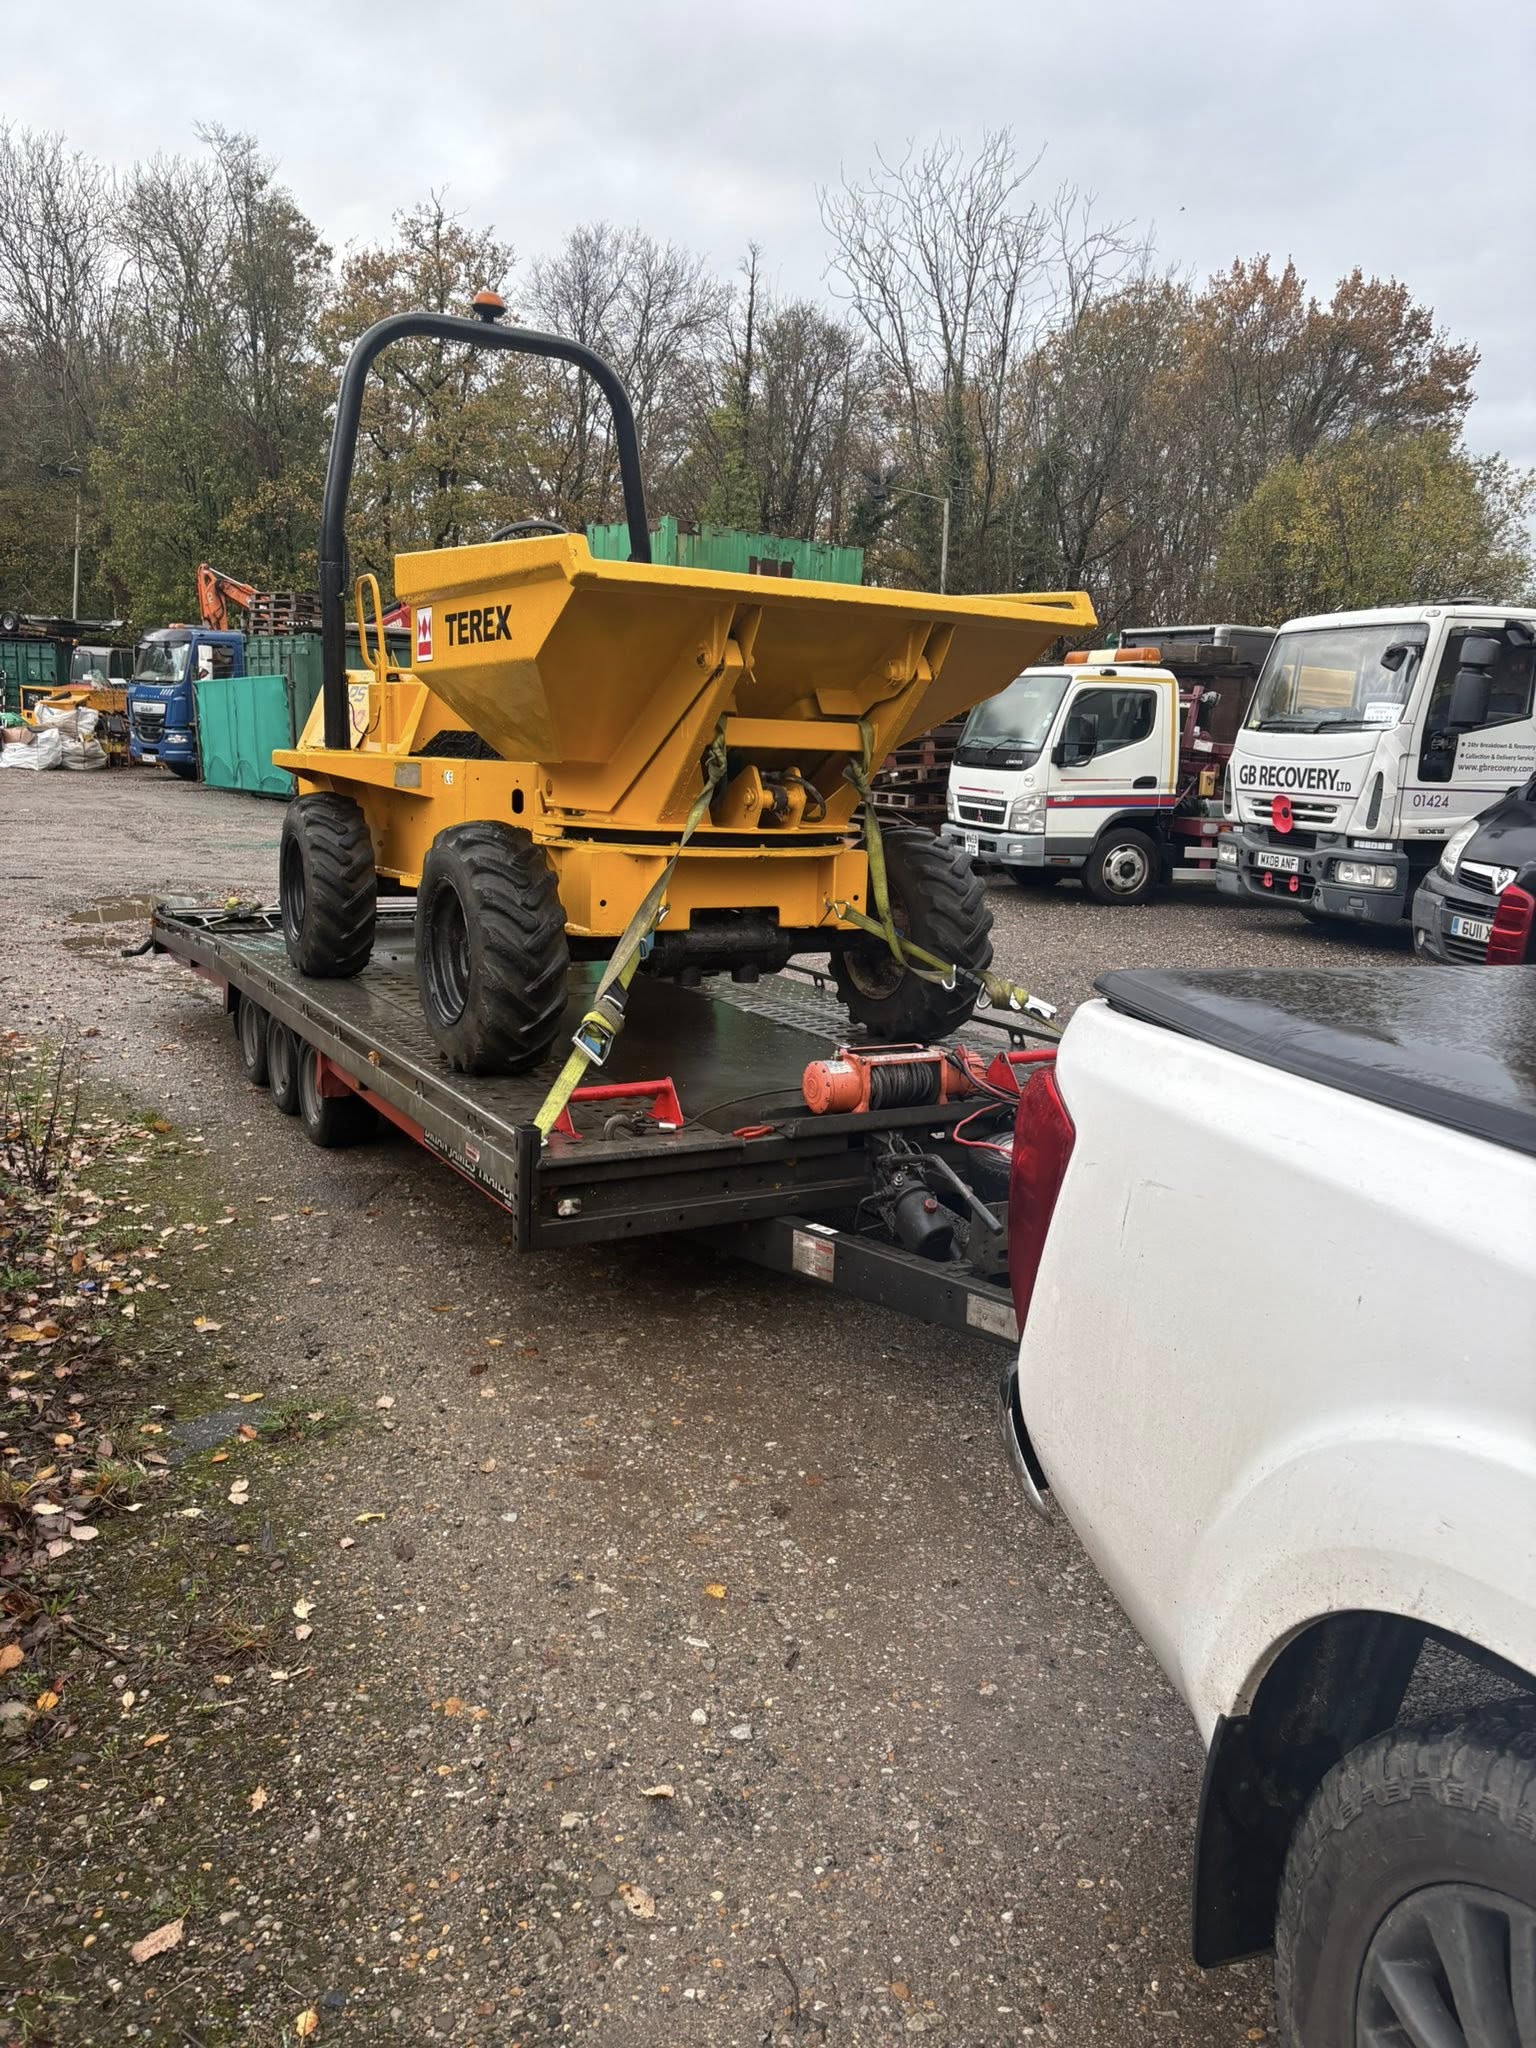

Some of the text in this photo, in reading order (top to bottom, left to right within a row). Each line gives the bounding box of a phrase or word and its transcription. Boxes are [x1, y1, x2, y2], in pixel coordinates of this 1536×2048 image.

[445, 604, 512, 646] TEREX
[1458, 763, 1534, 774] www.gbrecovery.com
[1239, 765, 1352, 792] GB RECOVERY LTD
[1413, 794, 1449, 808] 01424
[1260, 854, 1297, 869] MX08 ANF
